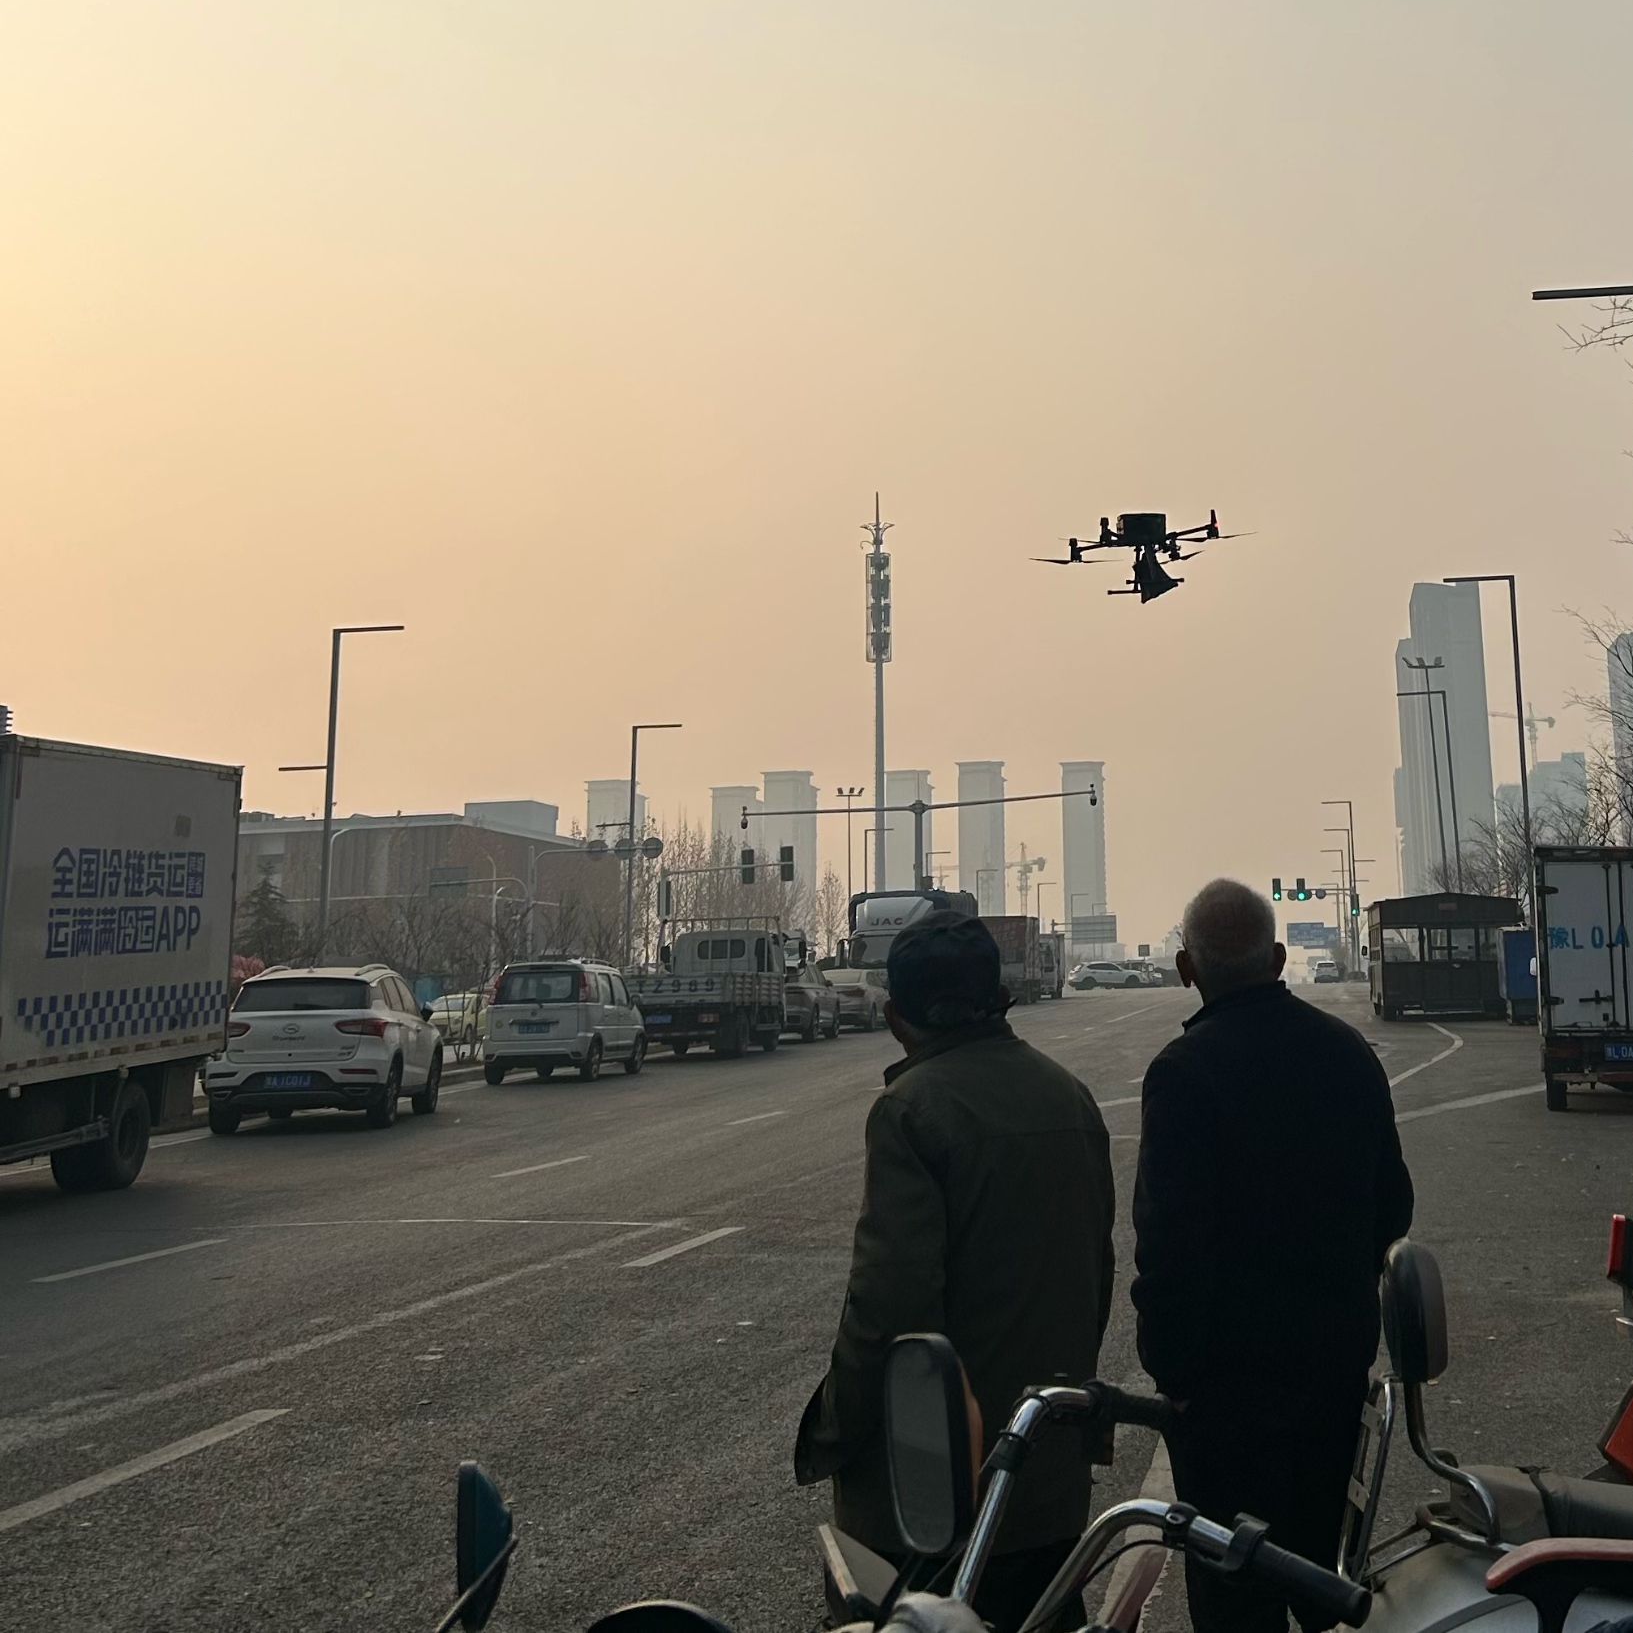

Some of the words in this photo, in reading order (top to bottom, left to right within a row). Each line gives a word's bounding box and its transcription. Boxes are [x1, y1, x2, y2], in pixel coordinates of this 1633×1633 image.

[51, 847, 187, 898] 全国冷链货运
[870, 916, 904, 927] JAC
